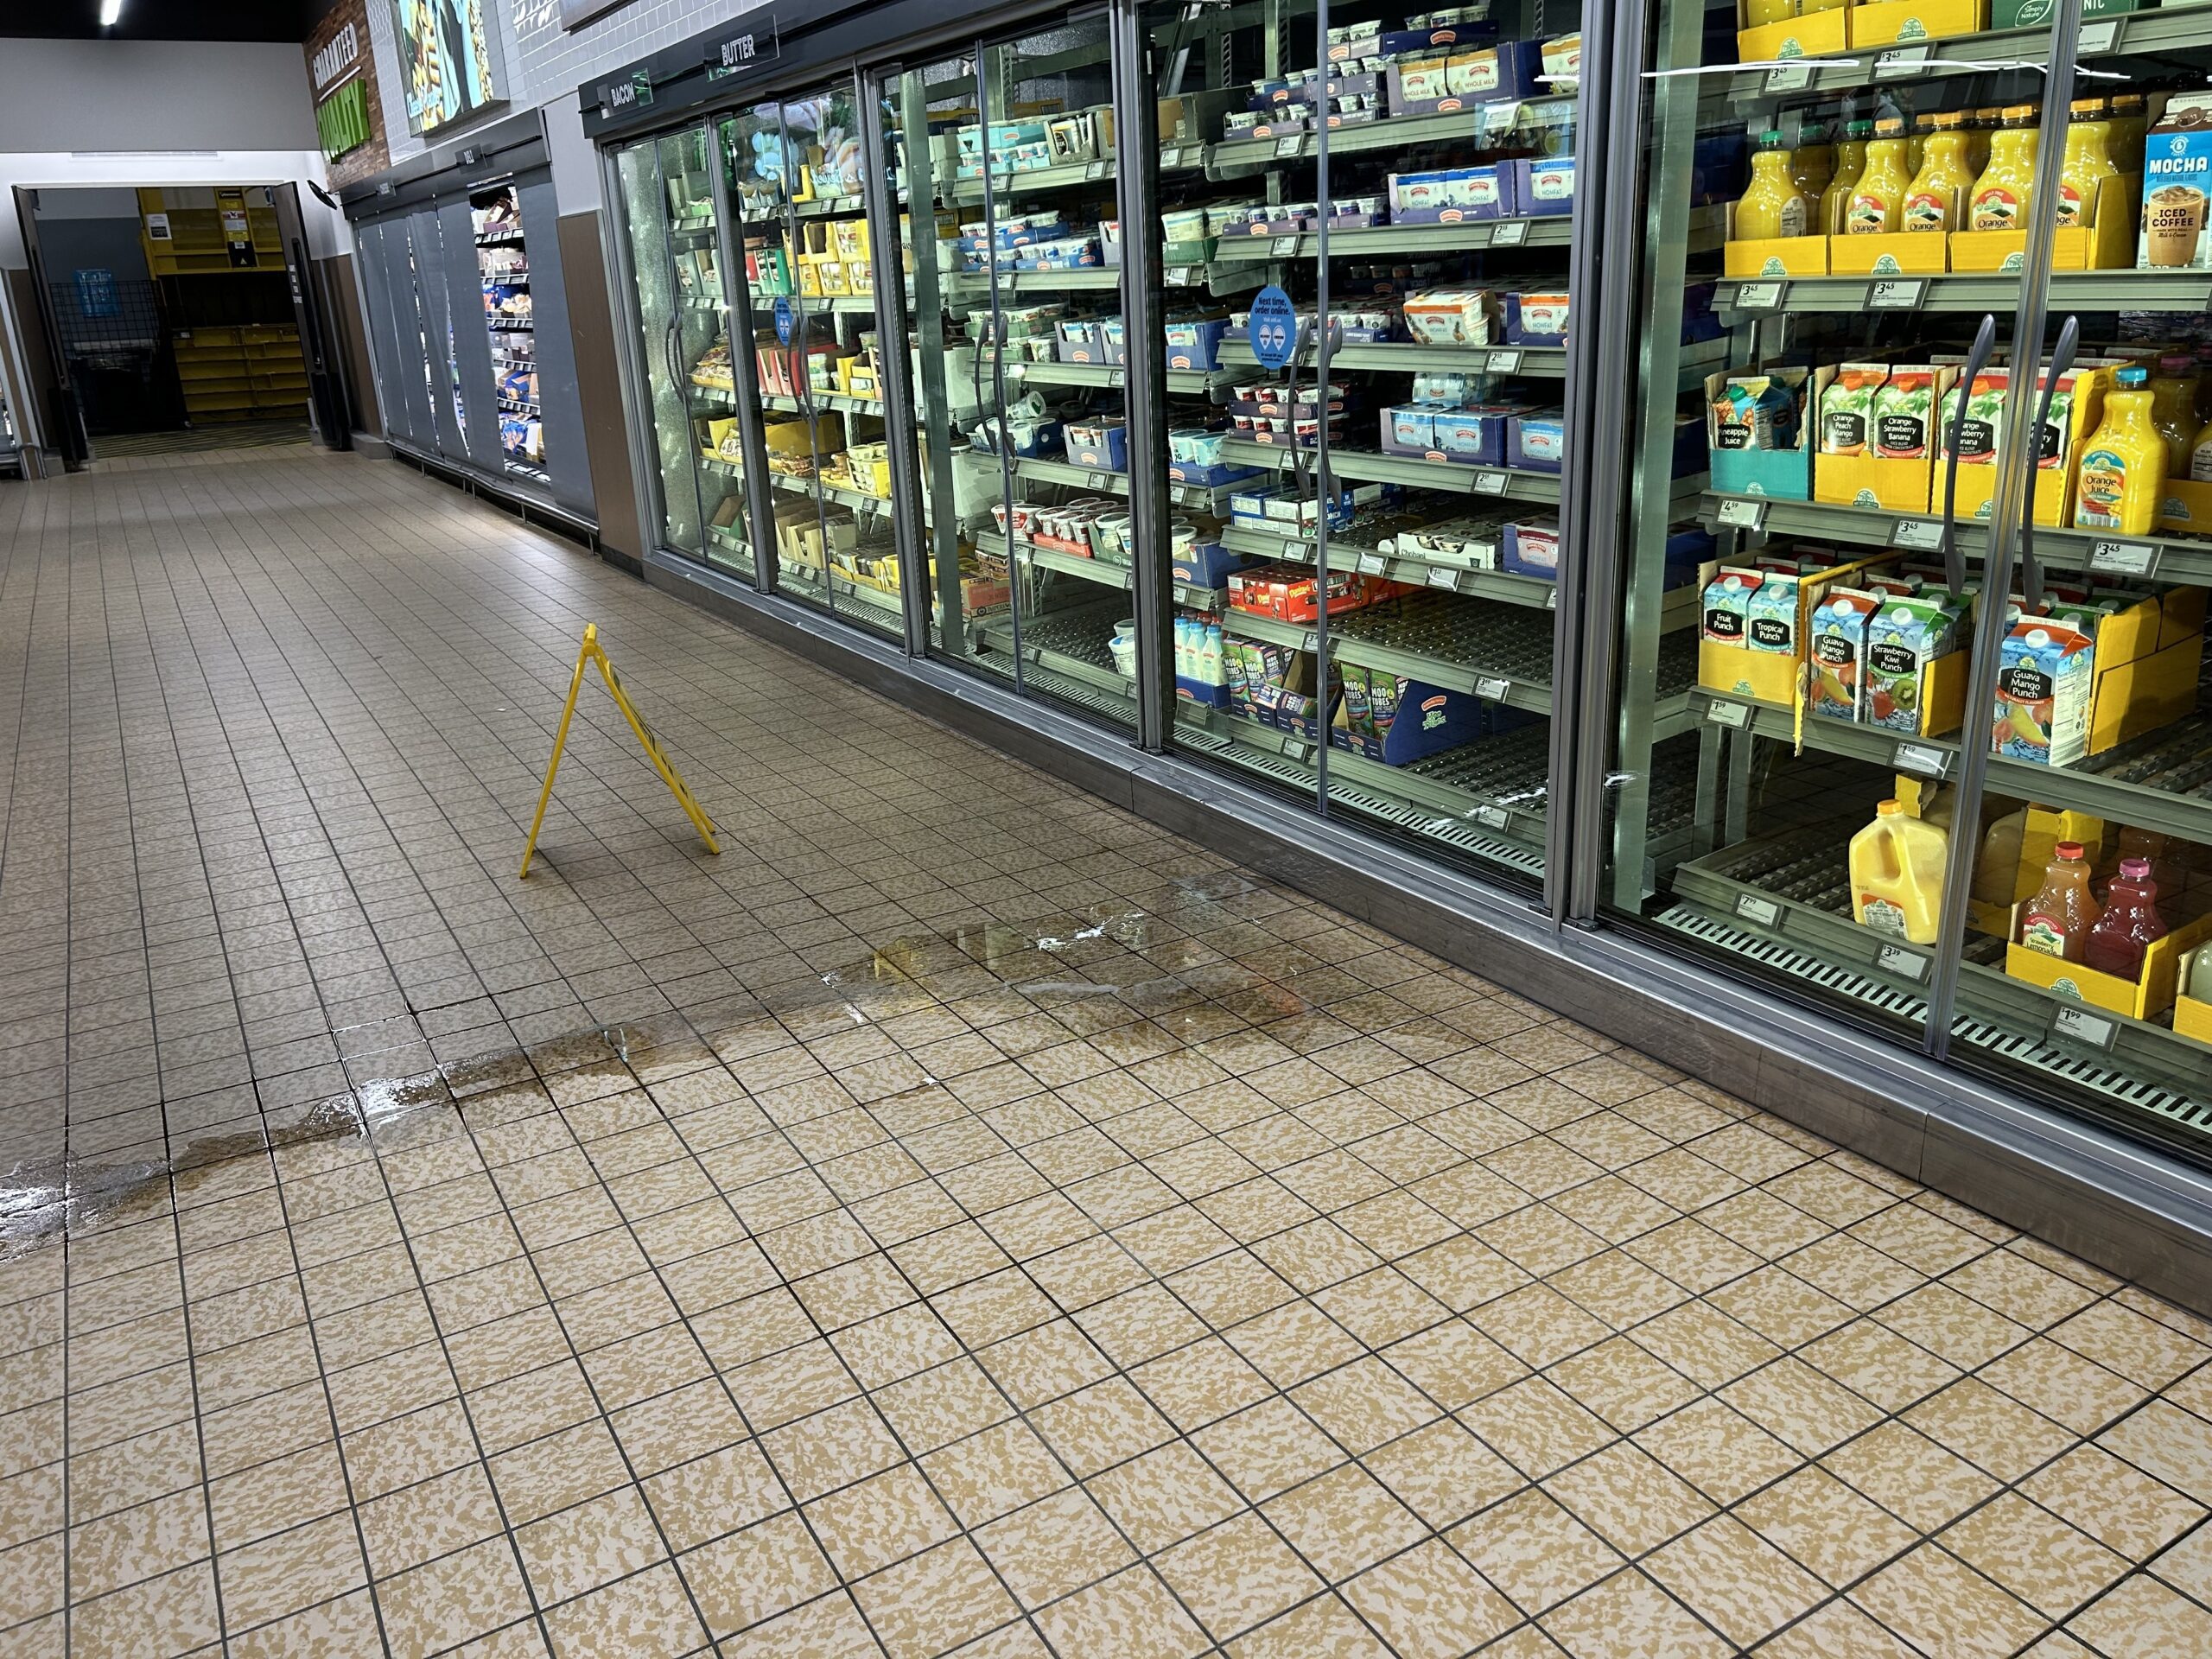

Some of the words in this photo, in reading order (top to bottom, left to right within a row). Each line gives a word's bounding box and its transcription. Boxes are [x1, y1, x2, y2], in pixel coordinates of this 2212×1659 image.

[2024, 5, 2044, 14] Simply
[721, 34, 756, 67] BUTTER
[610, 81, 636, 107] BACON
[2149, 156, 2209, 175] MOCHA
[2159, 208, 2187, 218] ICED
[1978, 219, 2008, 228] Orange
[2152, 217, 2194, 227] COFFEE
[1853, 225, 1878, 233] Orange
[1909, 223, 1936, 232] Orange
[1258, 296, 1271, 306] Next
[1272, 296, 1287, 307] time,
[1270, 306, 1291, 315] online.
[1833, 415, 1855, 423] Orange
[1888, 417, 1912, 426] Orange
[1718, 429, 1749, 437] Pineapple
[1833, 429, 1853, 437] Mango
[1884, 424, 1917, 435] Strawberry
[1725, 436, 1741, 445] Juice
[2086, 475, 2117, 486] Orange
[2090, 485, 2110, 494] Juice
[1402, 549, 1426, 560] Chobani
[1716, 613, 1732, 623] Fruit
[1713, 620, 1734, 632] Punch
[1757, 622, 1784, 634] Tropical
[1759, 631, 1780, 641] Punch
[1822, 636, 1845, 648] Guava
[1821, 644, 1845, 656] Mango
[1873, 645, 1913, 659] Strawberry
[1821, 652, 1843, 663] Punch
[1884, 654, 1899, 664] Kiwi
[1880, 661, 1903, 672] Punch
[2013, 670, 2040, 682] Guava
[1344, 681, 1358, 690] MOO
[2011, 678, 2040, 691] Mango
[1344, 690, 1362, 699] TUBES
[1371, 687, 1387, 697] MOO
[2012, 687, 2038, 699] Punch
[1372, 697, 1389, 706] TUBES
[2026, 942, 2057, 957] Lemonade
